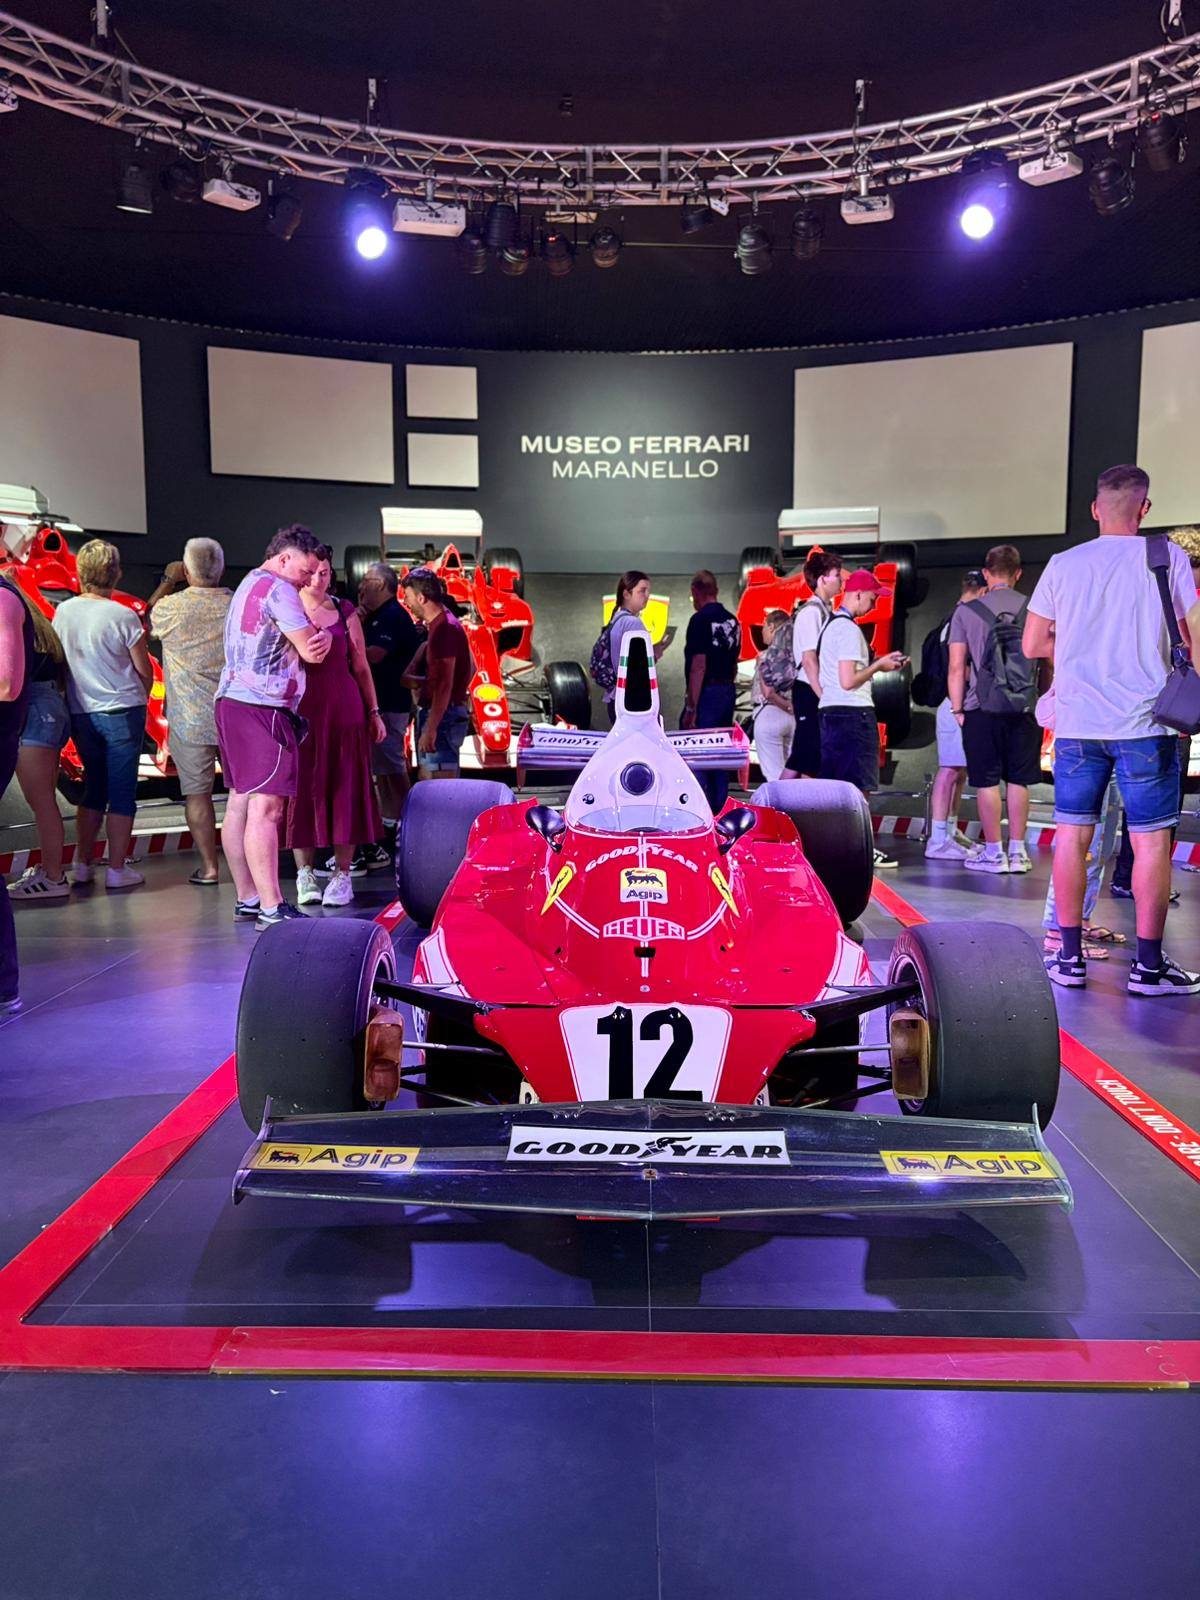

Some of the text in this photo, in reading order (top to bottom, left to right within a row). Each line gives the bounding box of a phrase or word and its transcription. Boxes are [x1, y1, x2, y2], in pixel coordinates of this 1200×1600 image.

[521, 434, 750, 454] MUSEO FERRARI
[552, 459, 719, 479] MARANELLO
[626, 888, 663, 900] Agip
[606, 918, 682, 940] HEUER
[597, 1006, 703, 1102] 12
[1094, 1079, 1147, 1106] TOUCH
[1127, 1106, 1183, 1133] DON'T
[308, 1147, 409, 1168] Agip
[943, 1153, 1042, 1175] Agip
